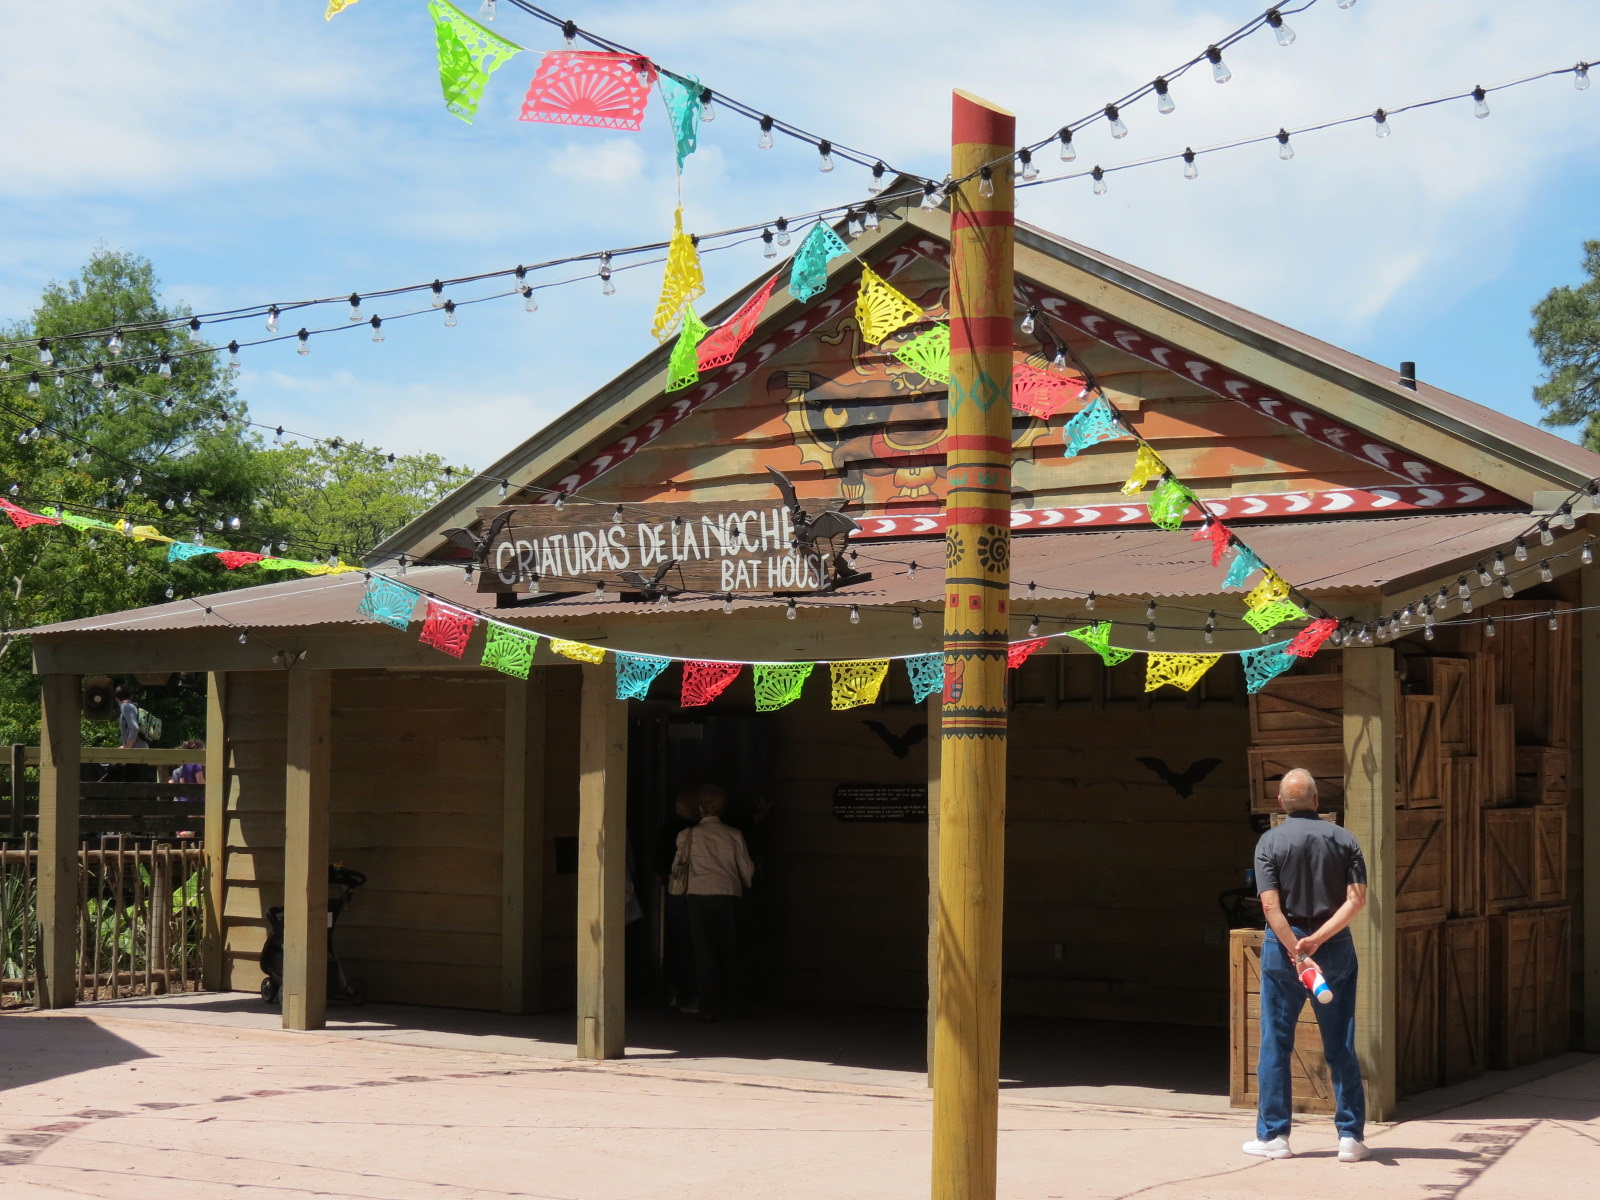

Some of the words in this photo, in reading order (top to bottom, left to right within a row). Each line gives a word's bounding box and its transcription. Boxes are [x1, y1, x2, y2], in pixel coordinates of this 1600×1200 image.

[497, 526, 630, 584] CRIATURAS
[638, 523, 668, 567] DE
[672, 520, 701, 561] LA
[721, 559, 762, 591] BAT
[768, 553, 831, 589] HOUSE
